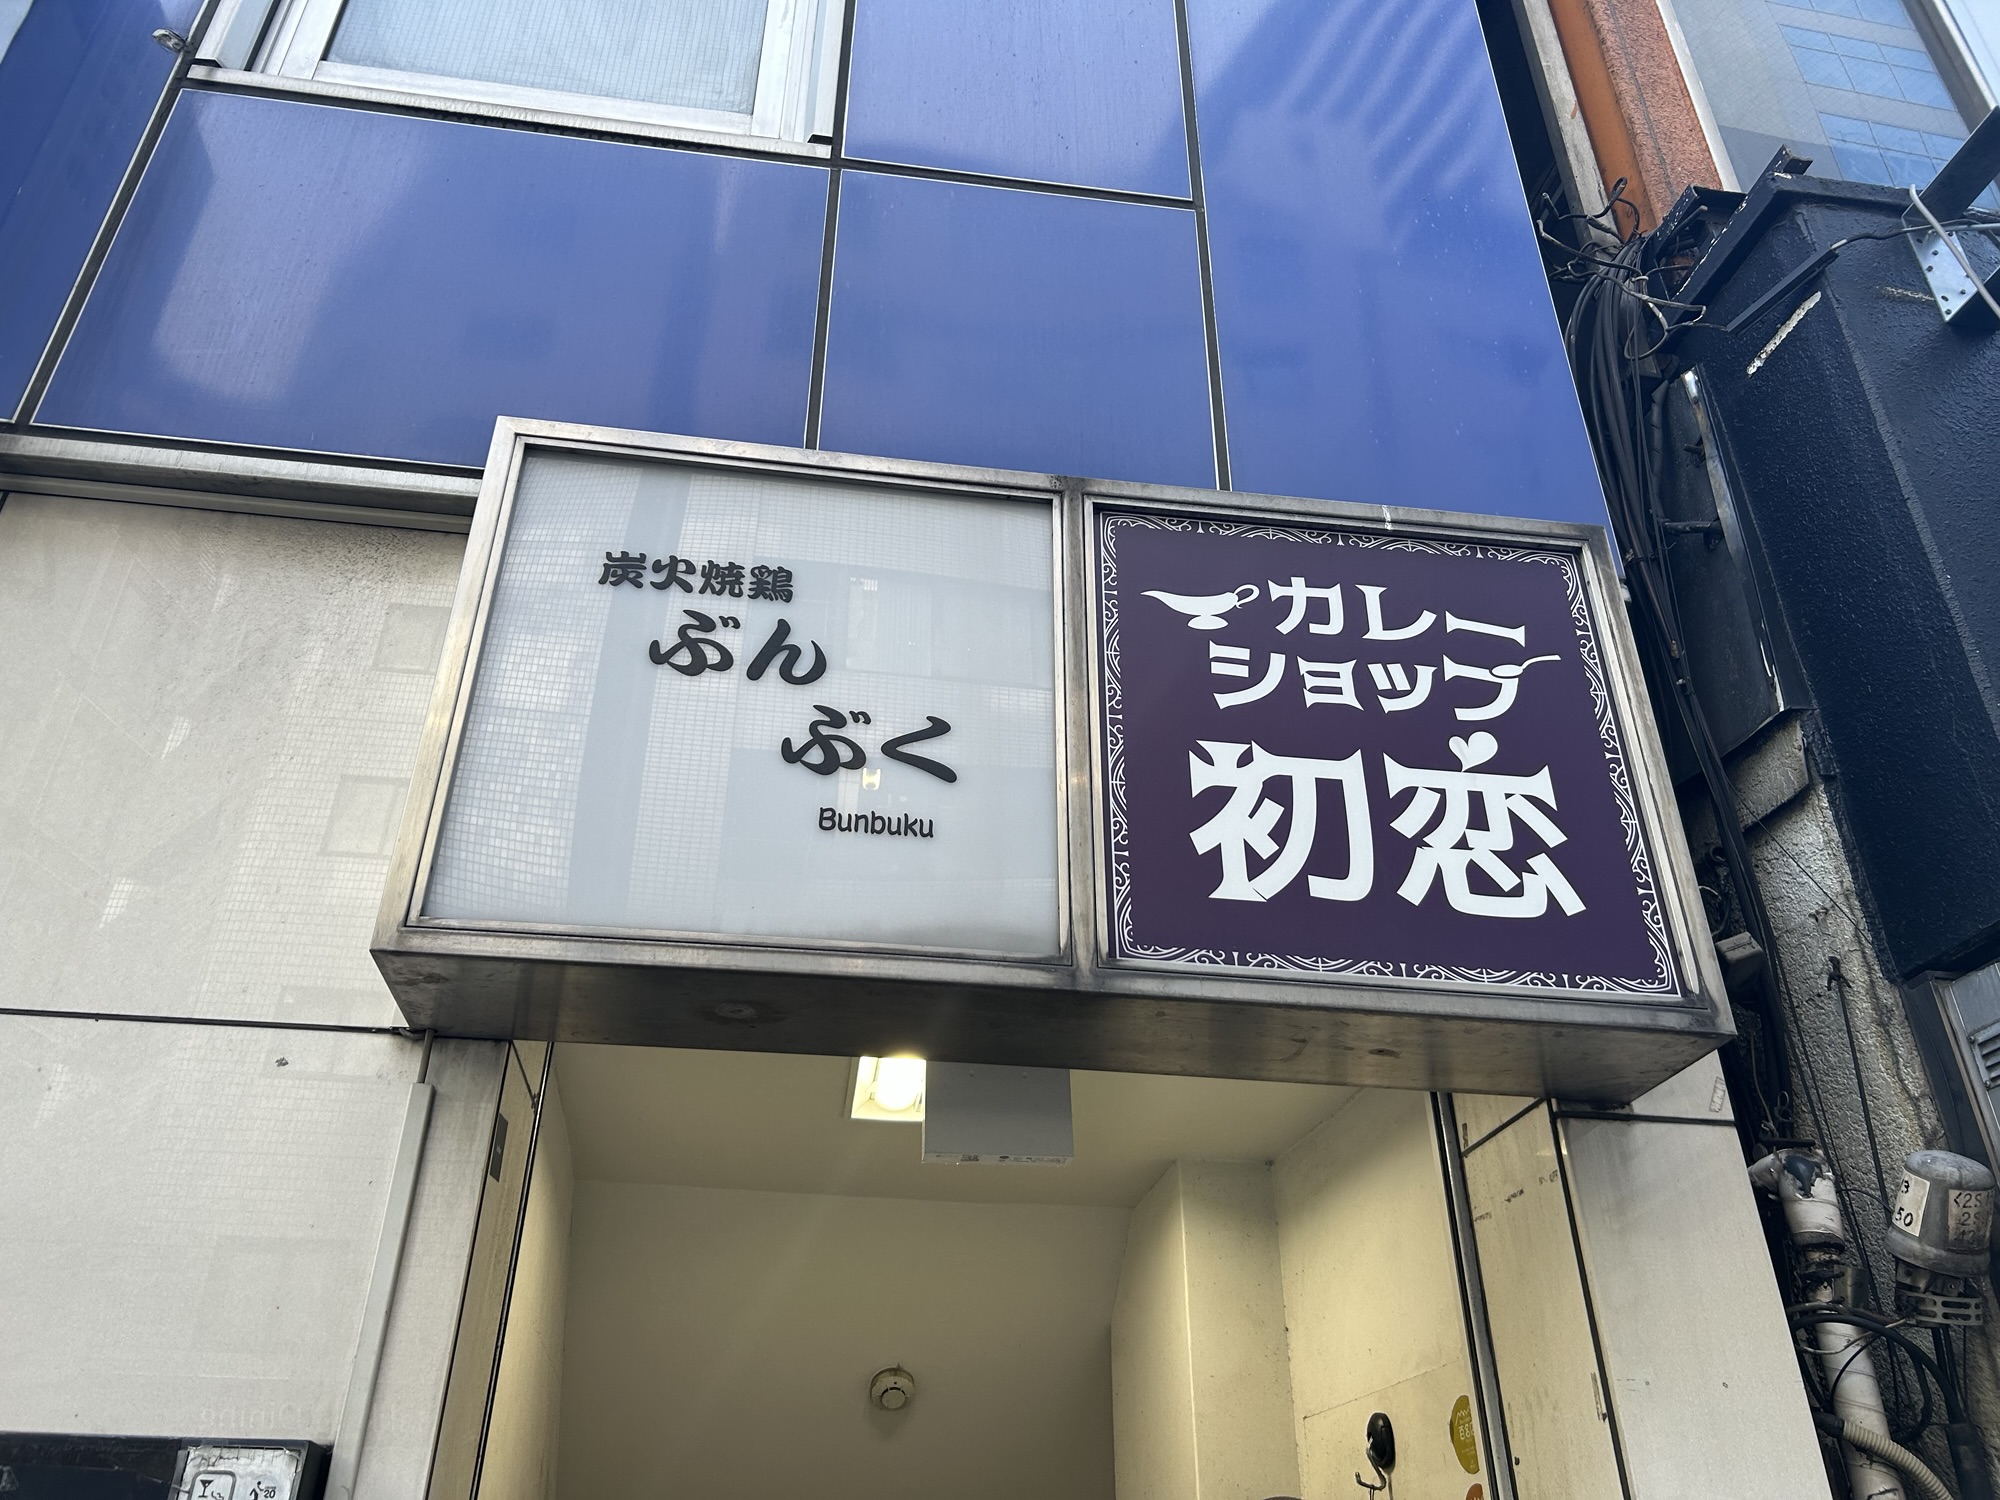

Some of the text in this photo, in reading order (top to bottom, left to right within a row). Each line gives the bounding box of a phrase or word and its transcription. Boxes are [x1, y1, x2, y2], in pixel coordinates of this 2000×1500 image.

[598, 550, 794, 603] 炭火焼鶏
[1267, 576, 1526, 647] カレー
[648, 608, 828, 686] ぶん
[1208, 640, 1561, 721] ショップ
[780, 704, 958, 784] ぶく
[817, 805, 935, 839] Bunbuku
[1188, 731, 1587, 919] 初恋
